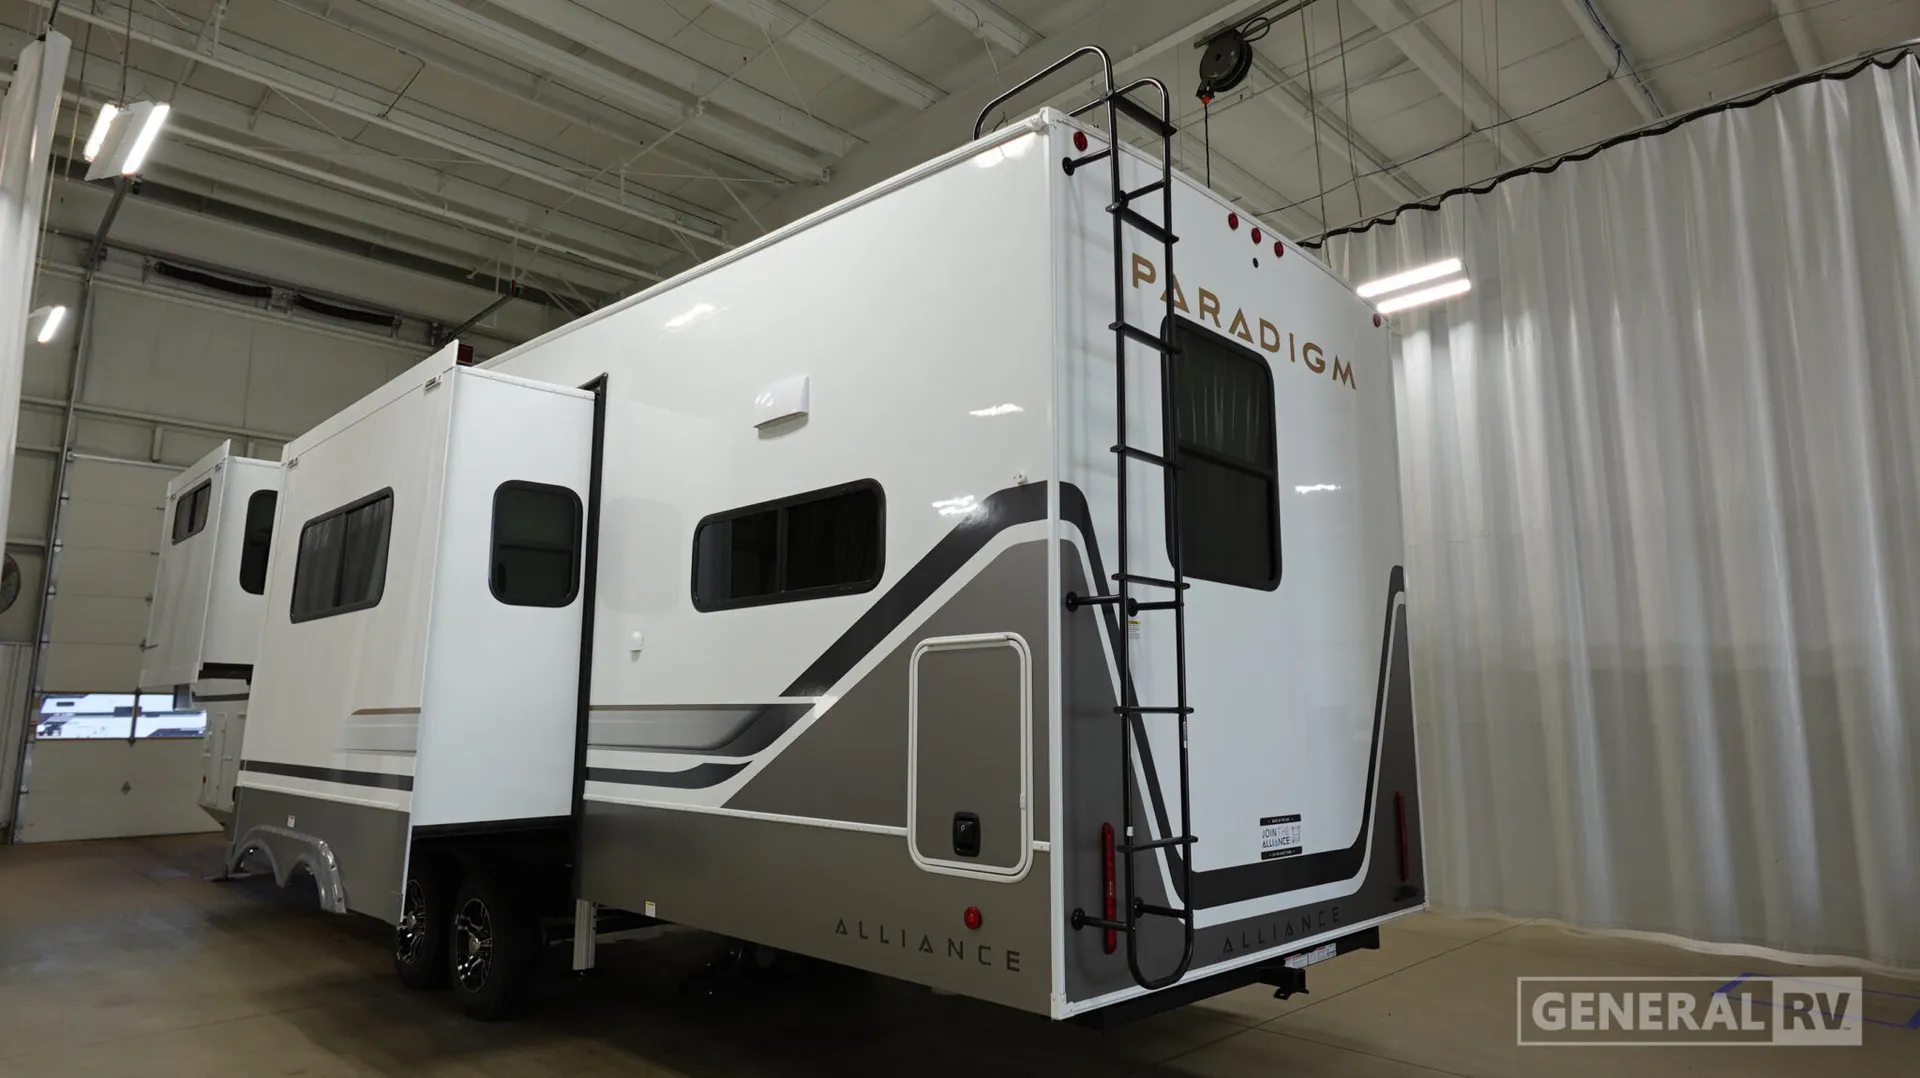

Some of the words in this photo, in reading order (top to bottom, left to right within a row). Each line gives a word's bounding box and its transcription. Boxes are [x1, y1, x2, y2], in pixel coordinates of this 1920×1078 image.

[1132, 252, 1356, 390] PARADIGM
[1262, 828, 1277, 838] JOIN
[1278, 826, 1290, 836] THE
[1262, 836, 1290, 848] ALLIANCE
[835, 917, 1020, 972] ALLIANCE
[1222, 906, 1340, 954] ALLIANCE
